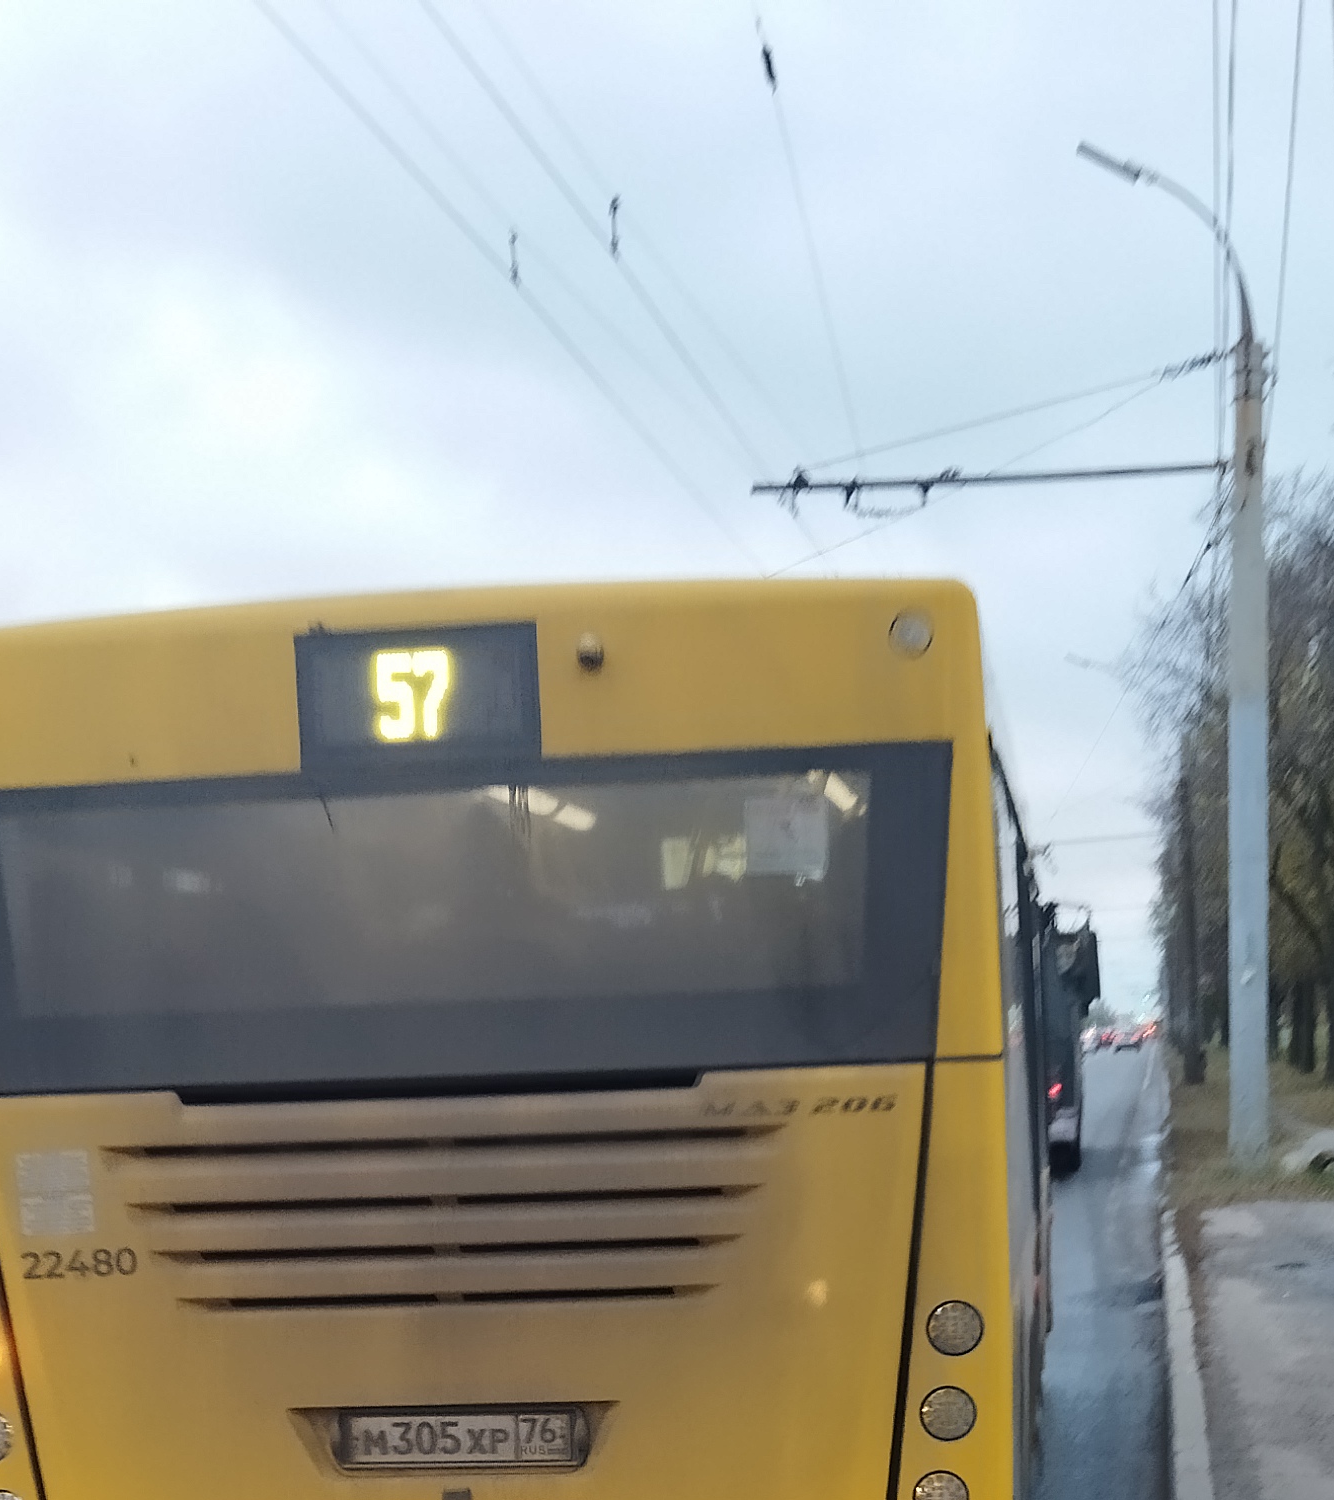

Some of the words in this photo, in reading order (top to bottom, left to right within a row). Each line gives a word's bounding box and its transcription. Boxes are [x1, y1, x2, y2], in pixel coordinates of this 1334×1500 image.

[371, 648, 453, 742] 57
[808, 1093, 899, 1116] 206
[20, 1247, 138, 1279] 22480
[362, 1420, 510, 1456] М305ХР
[520, 1417, 556, 1444] 76
[521, 1444, 547, 1455] RUS
